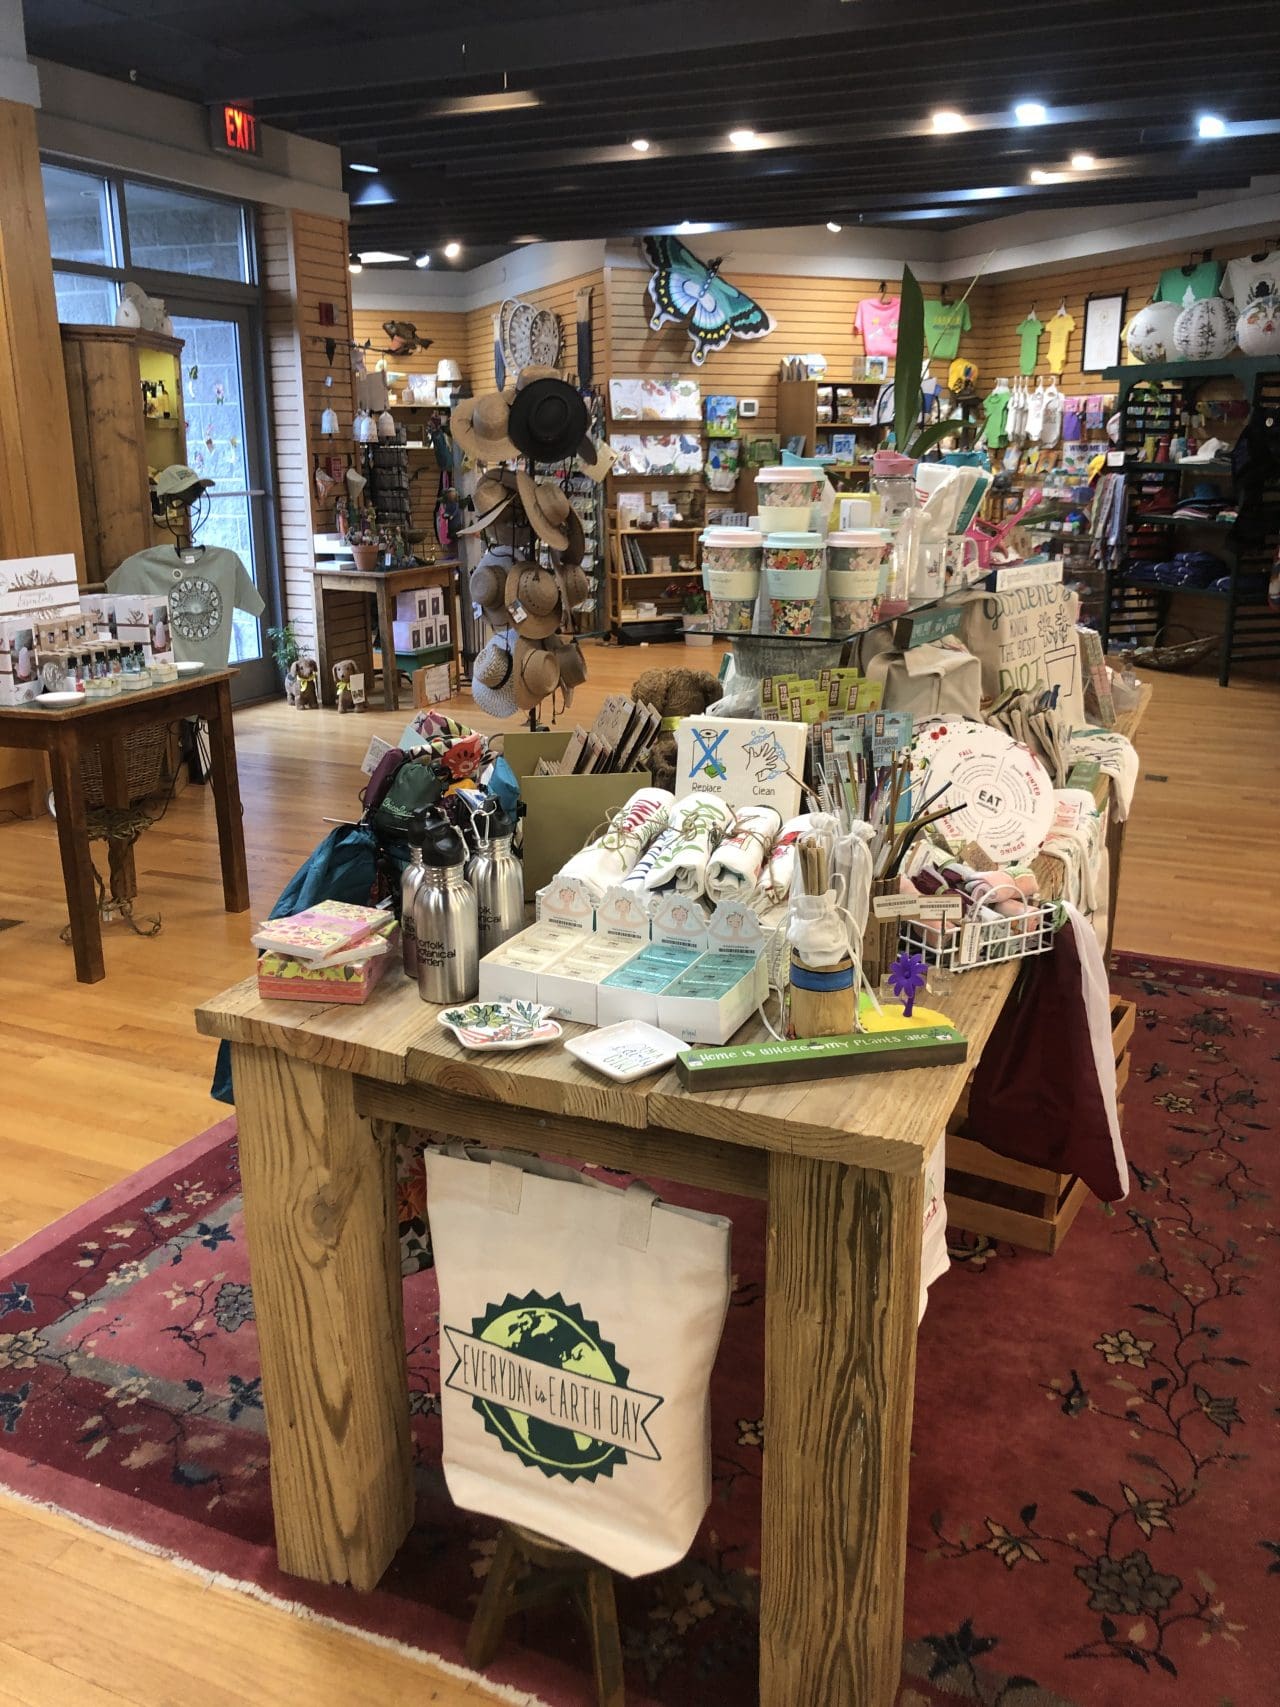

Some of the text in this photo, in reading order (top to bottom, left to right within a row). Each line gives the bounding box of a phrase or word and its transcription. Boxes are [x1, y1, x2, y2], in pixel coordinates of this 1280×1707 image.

[224, 106, 256, 152] EXIT
[958, 748, 973, 758] FALL
[691, 782, 722, 793] Replace
[752, 785, 776, 796] Clean
[1025, 771, 1041, 797] WINTER
[978, 790, 1002, 808] EAT
[1000, 840, 1026, 856] SPRING
[417, 939, 444, 950] orfolk
[417, 948, 457, 959] otanical
[699, 1052, 738, 1062] Home
[742, 1049, 756, 1057] is
[463, 1344, 641, 1443] EVERYDAY is EARTH DAY
